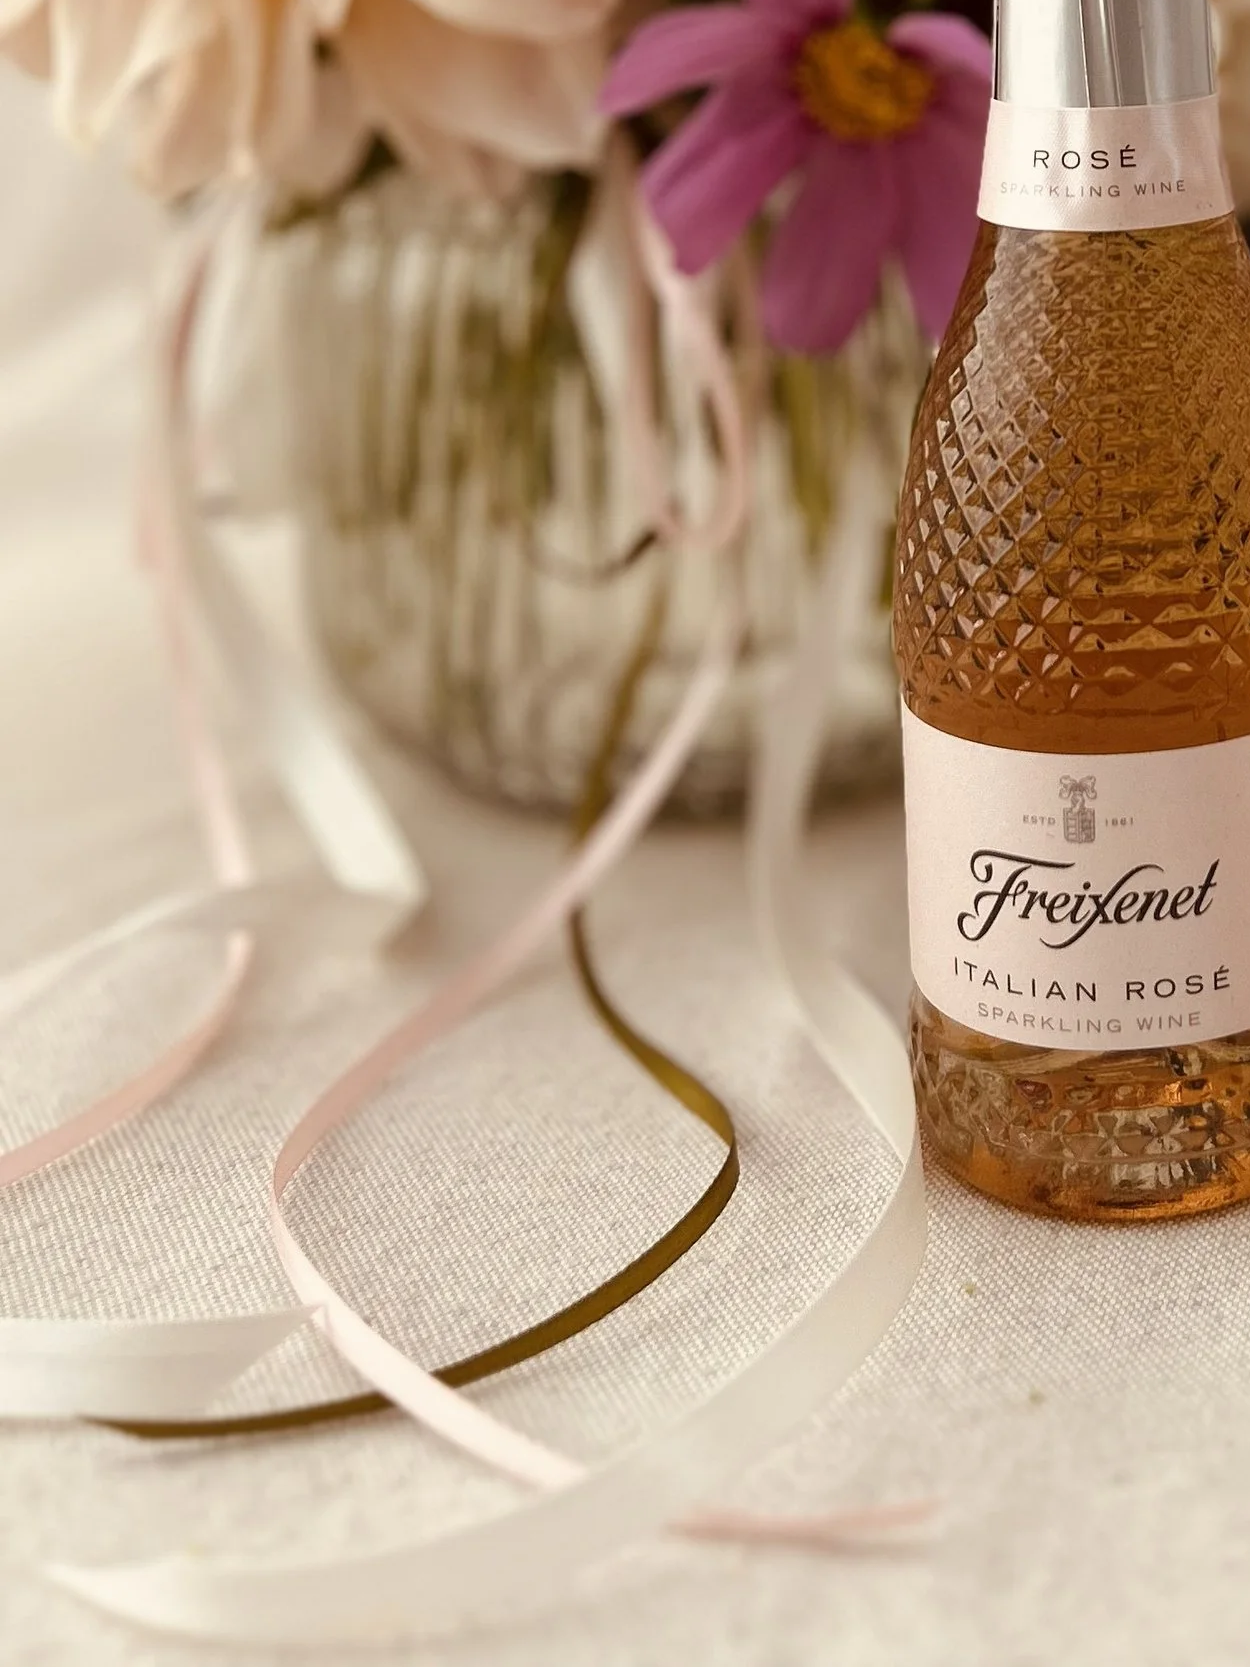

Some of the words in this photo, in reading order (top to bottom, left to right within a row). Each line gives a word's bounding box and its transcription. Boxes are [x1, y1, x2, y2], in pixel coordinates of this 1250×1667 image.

[1033, 144, 1137, 170] ROSÉ
[1000, 181, 1121, 198] SPARKLING
[1134, 179, 1187, 196] WINE
[956, 848, 1221, 950] Freixenet
[953, 956, 1098, 1003] ITALIAN
[1125, 965, 1232, 1001] ROSÉ
[977, 1001, 1123, 1034] SPARKLING
[1136, 1010, 1203, 1031] WINE
